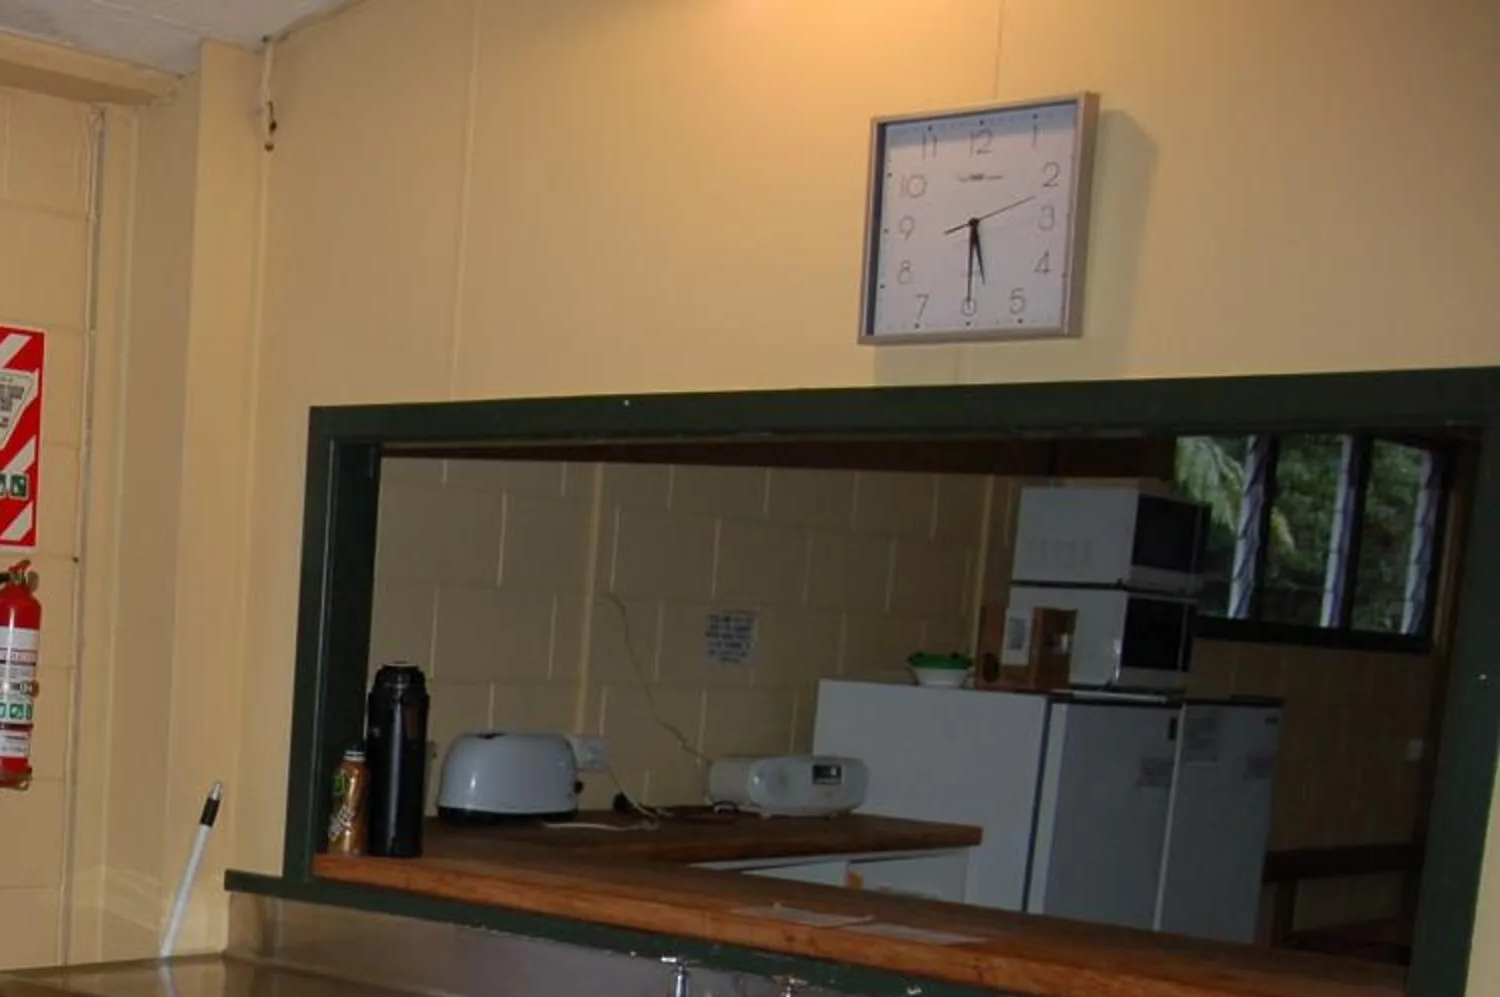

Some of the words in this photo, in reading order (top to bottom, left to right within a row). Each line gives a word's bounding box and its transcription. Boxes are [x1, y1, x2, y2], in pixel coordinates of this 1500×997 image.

[921, 131, 938, 160] 11
[969, 129, 993, 155] 12
[901, 174, 927, 198] 10
[1043, 161, 1060, 187] 2
[899, 216, 915, 242] 9
[1038, 204, 1056, 231] 3
[898, 260, 913, 285] 8
[1034, 251, 1051, 276] 4
[916, 294, 930, 320] 7
[1009, 287, 1026, 315] 5
